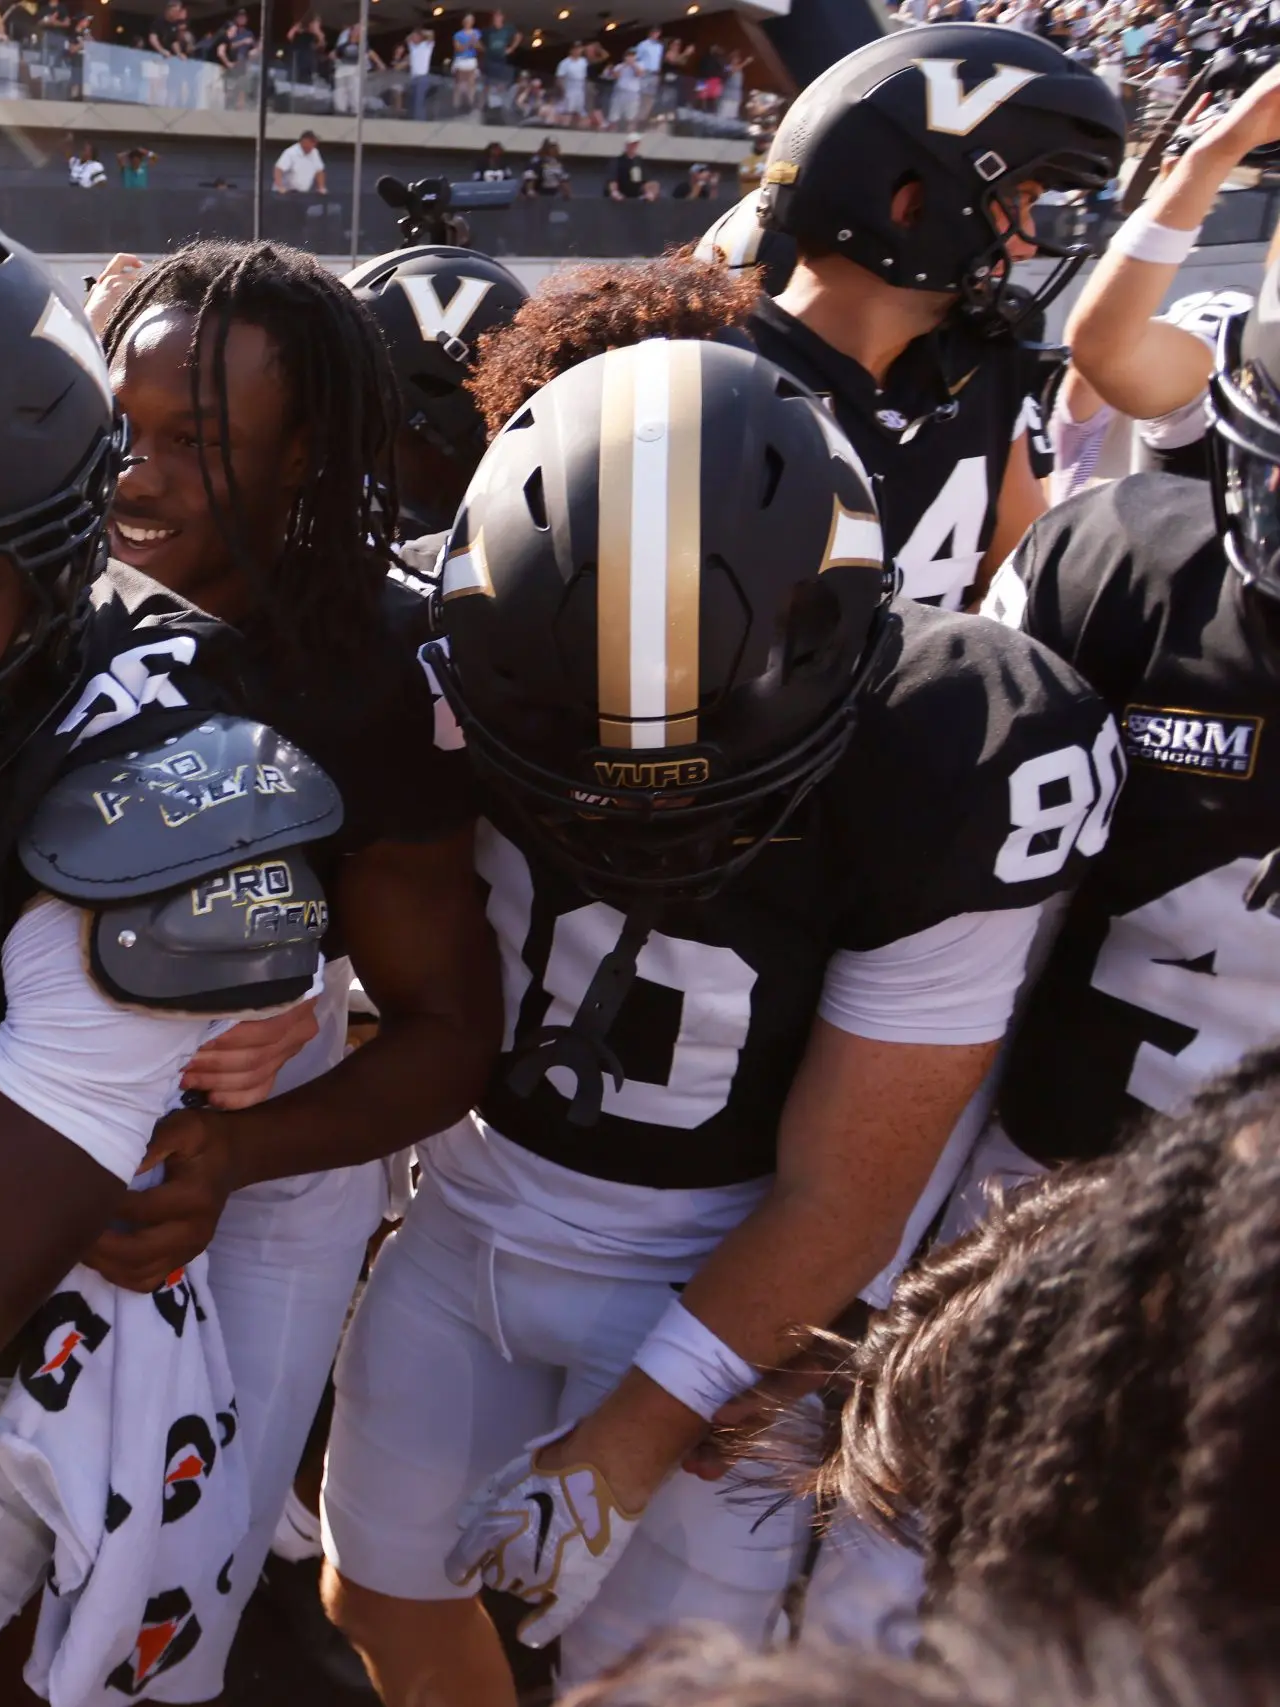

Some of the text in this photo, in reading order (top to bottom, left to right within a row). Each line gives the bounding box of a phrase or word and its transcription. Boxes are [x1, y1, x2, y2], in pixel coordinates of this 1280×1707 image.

[909, 58, 1047, 137] V
[392, 274, 497, 342] V
[1126, 745, 1247, 771] CONCRETE
[1147, 716, 1253, 757] SRM
[594, 757, 710, 788] VUFB
[993, 711, 1128, 883] 80
[191, 860, 294, 915] PRO
